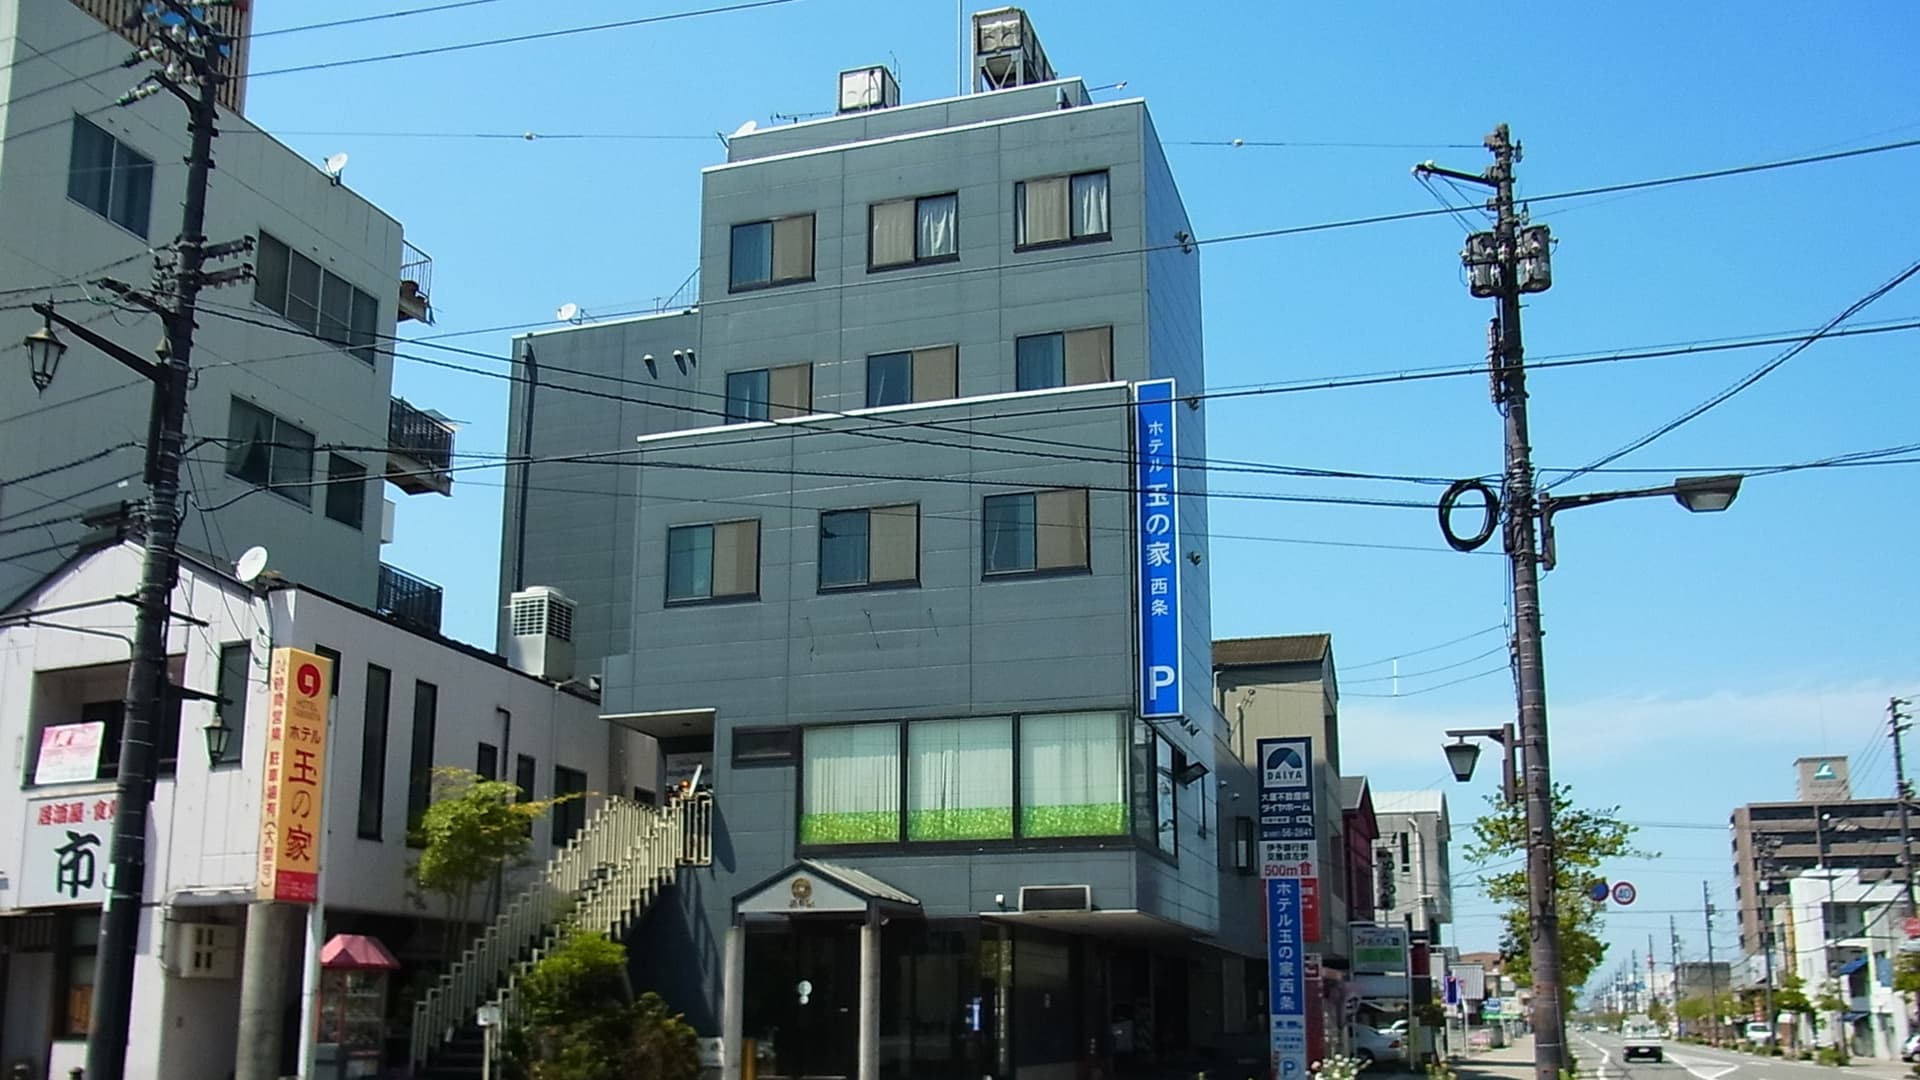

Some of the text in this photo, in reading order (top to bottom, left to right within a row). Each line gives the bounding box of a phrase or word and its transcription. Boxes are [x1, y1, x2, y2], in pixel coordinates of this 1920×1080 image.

[1145, 421, 1171, 617] ホテル 玉の家 西条
[1150, 666, 1175, 701] P
[289, 725, 321, 744] ホテル
[1267, 771, 1302, 780] DAIYA
[285, 749, 317, 862] 玉の家
[1265, 864, 1298, 876] 500m
[1618, 888, 1631, 898] 40
[1277, 881, 1295, 1010] ホテル玉の家西条
[1283, 1060, 1296, 1076] P
